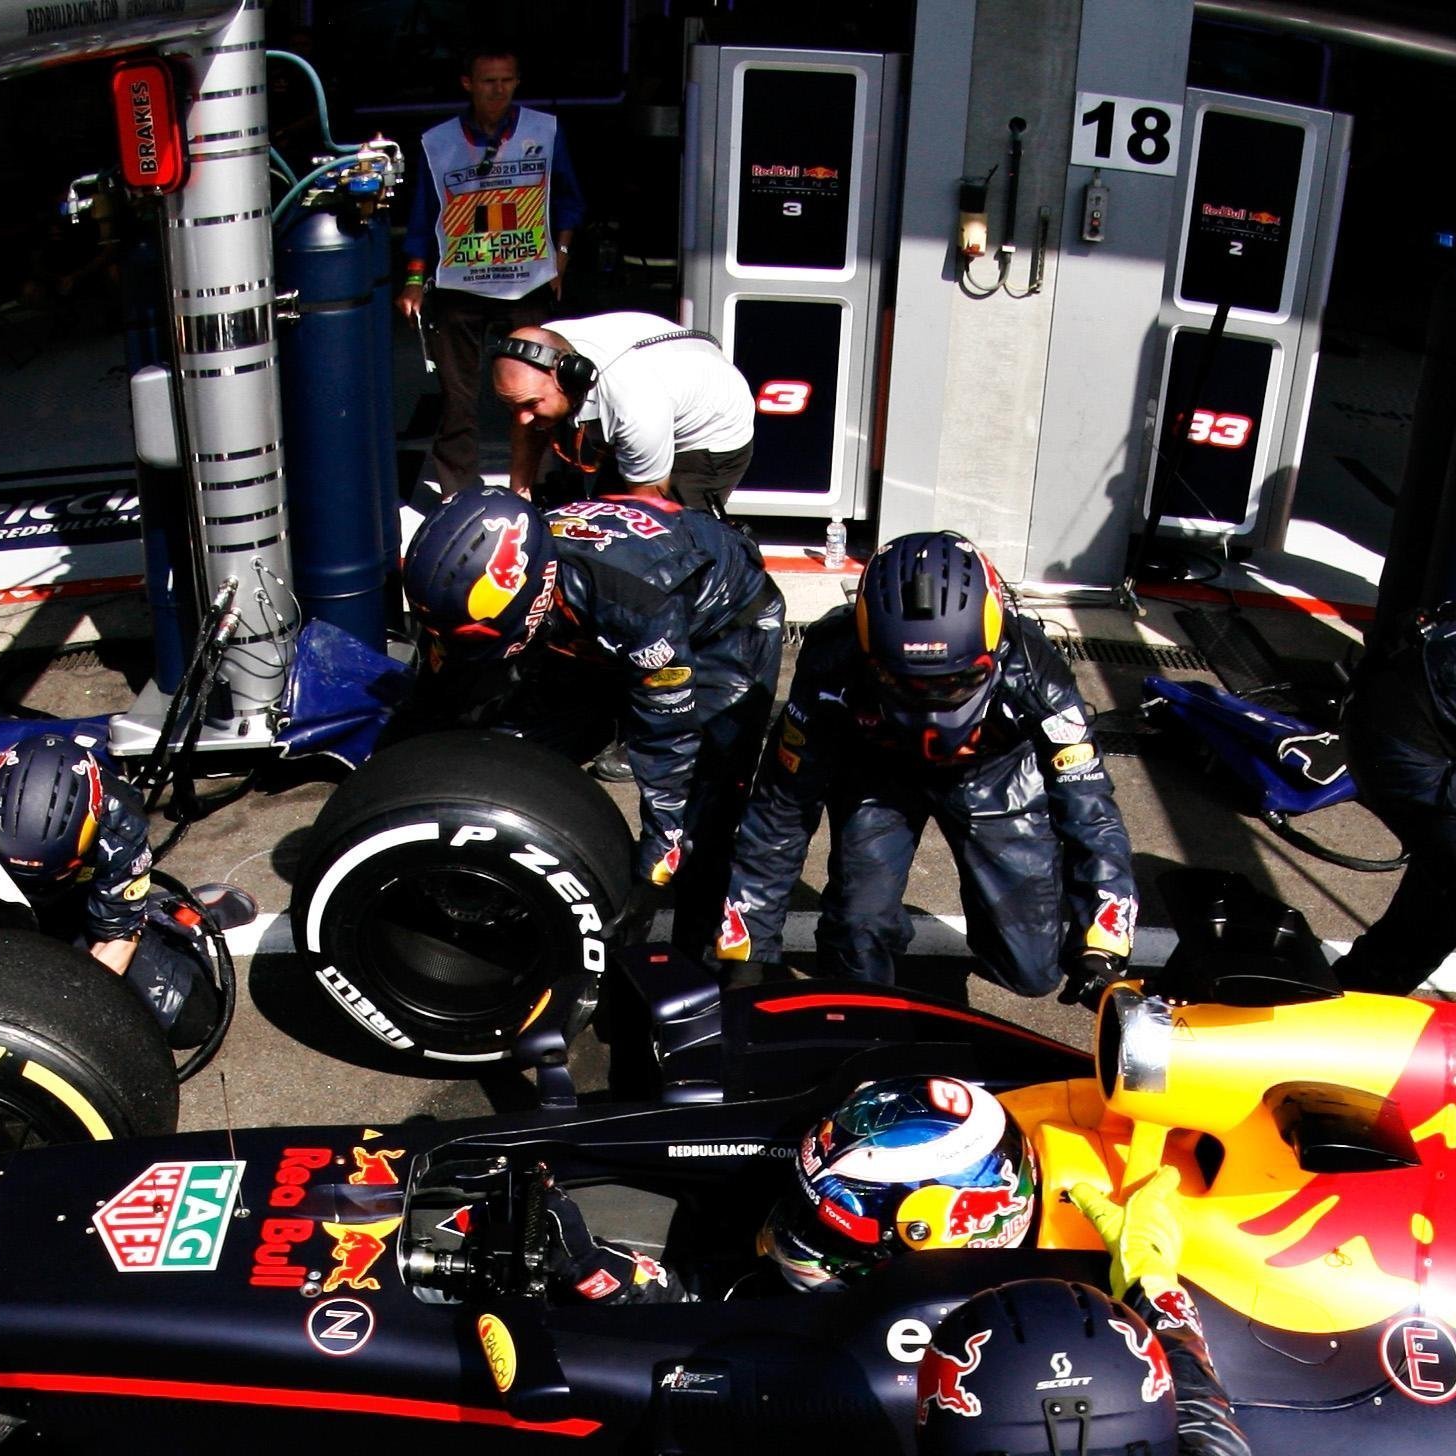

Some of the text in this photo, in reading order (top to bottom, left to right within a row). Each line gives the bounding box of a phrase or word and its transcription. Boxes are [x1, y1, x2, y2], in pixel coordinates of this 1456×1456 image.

[131, 80, 159, 176] BRAKES
[1082, 100, 1171, 165] 18
[783, 202, 802, 216] 3
[1229, 241, 1243, 256] 2
[756, 380, 812, 415] 3
[450, 825, 606, 974] P ZERO
[668, 1143, 798, 1159] REDBULLRACING.COM
[102, 1167, 175, 1268] HEUER
[168, 1166, 233, 1260] TAG
[824, 1204, 852, 1230] TOTAL
[249, 1218, 316, 1287] Bull
[485, 1331, 508, 1385] RAUCH
[1035, 1376, 1093, 1391] SCOTT
[1405, 1326, 1445, 1393] E
